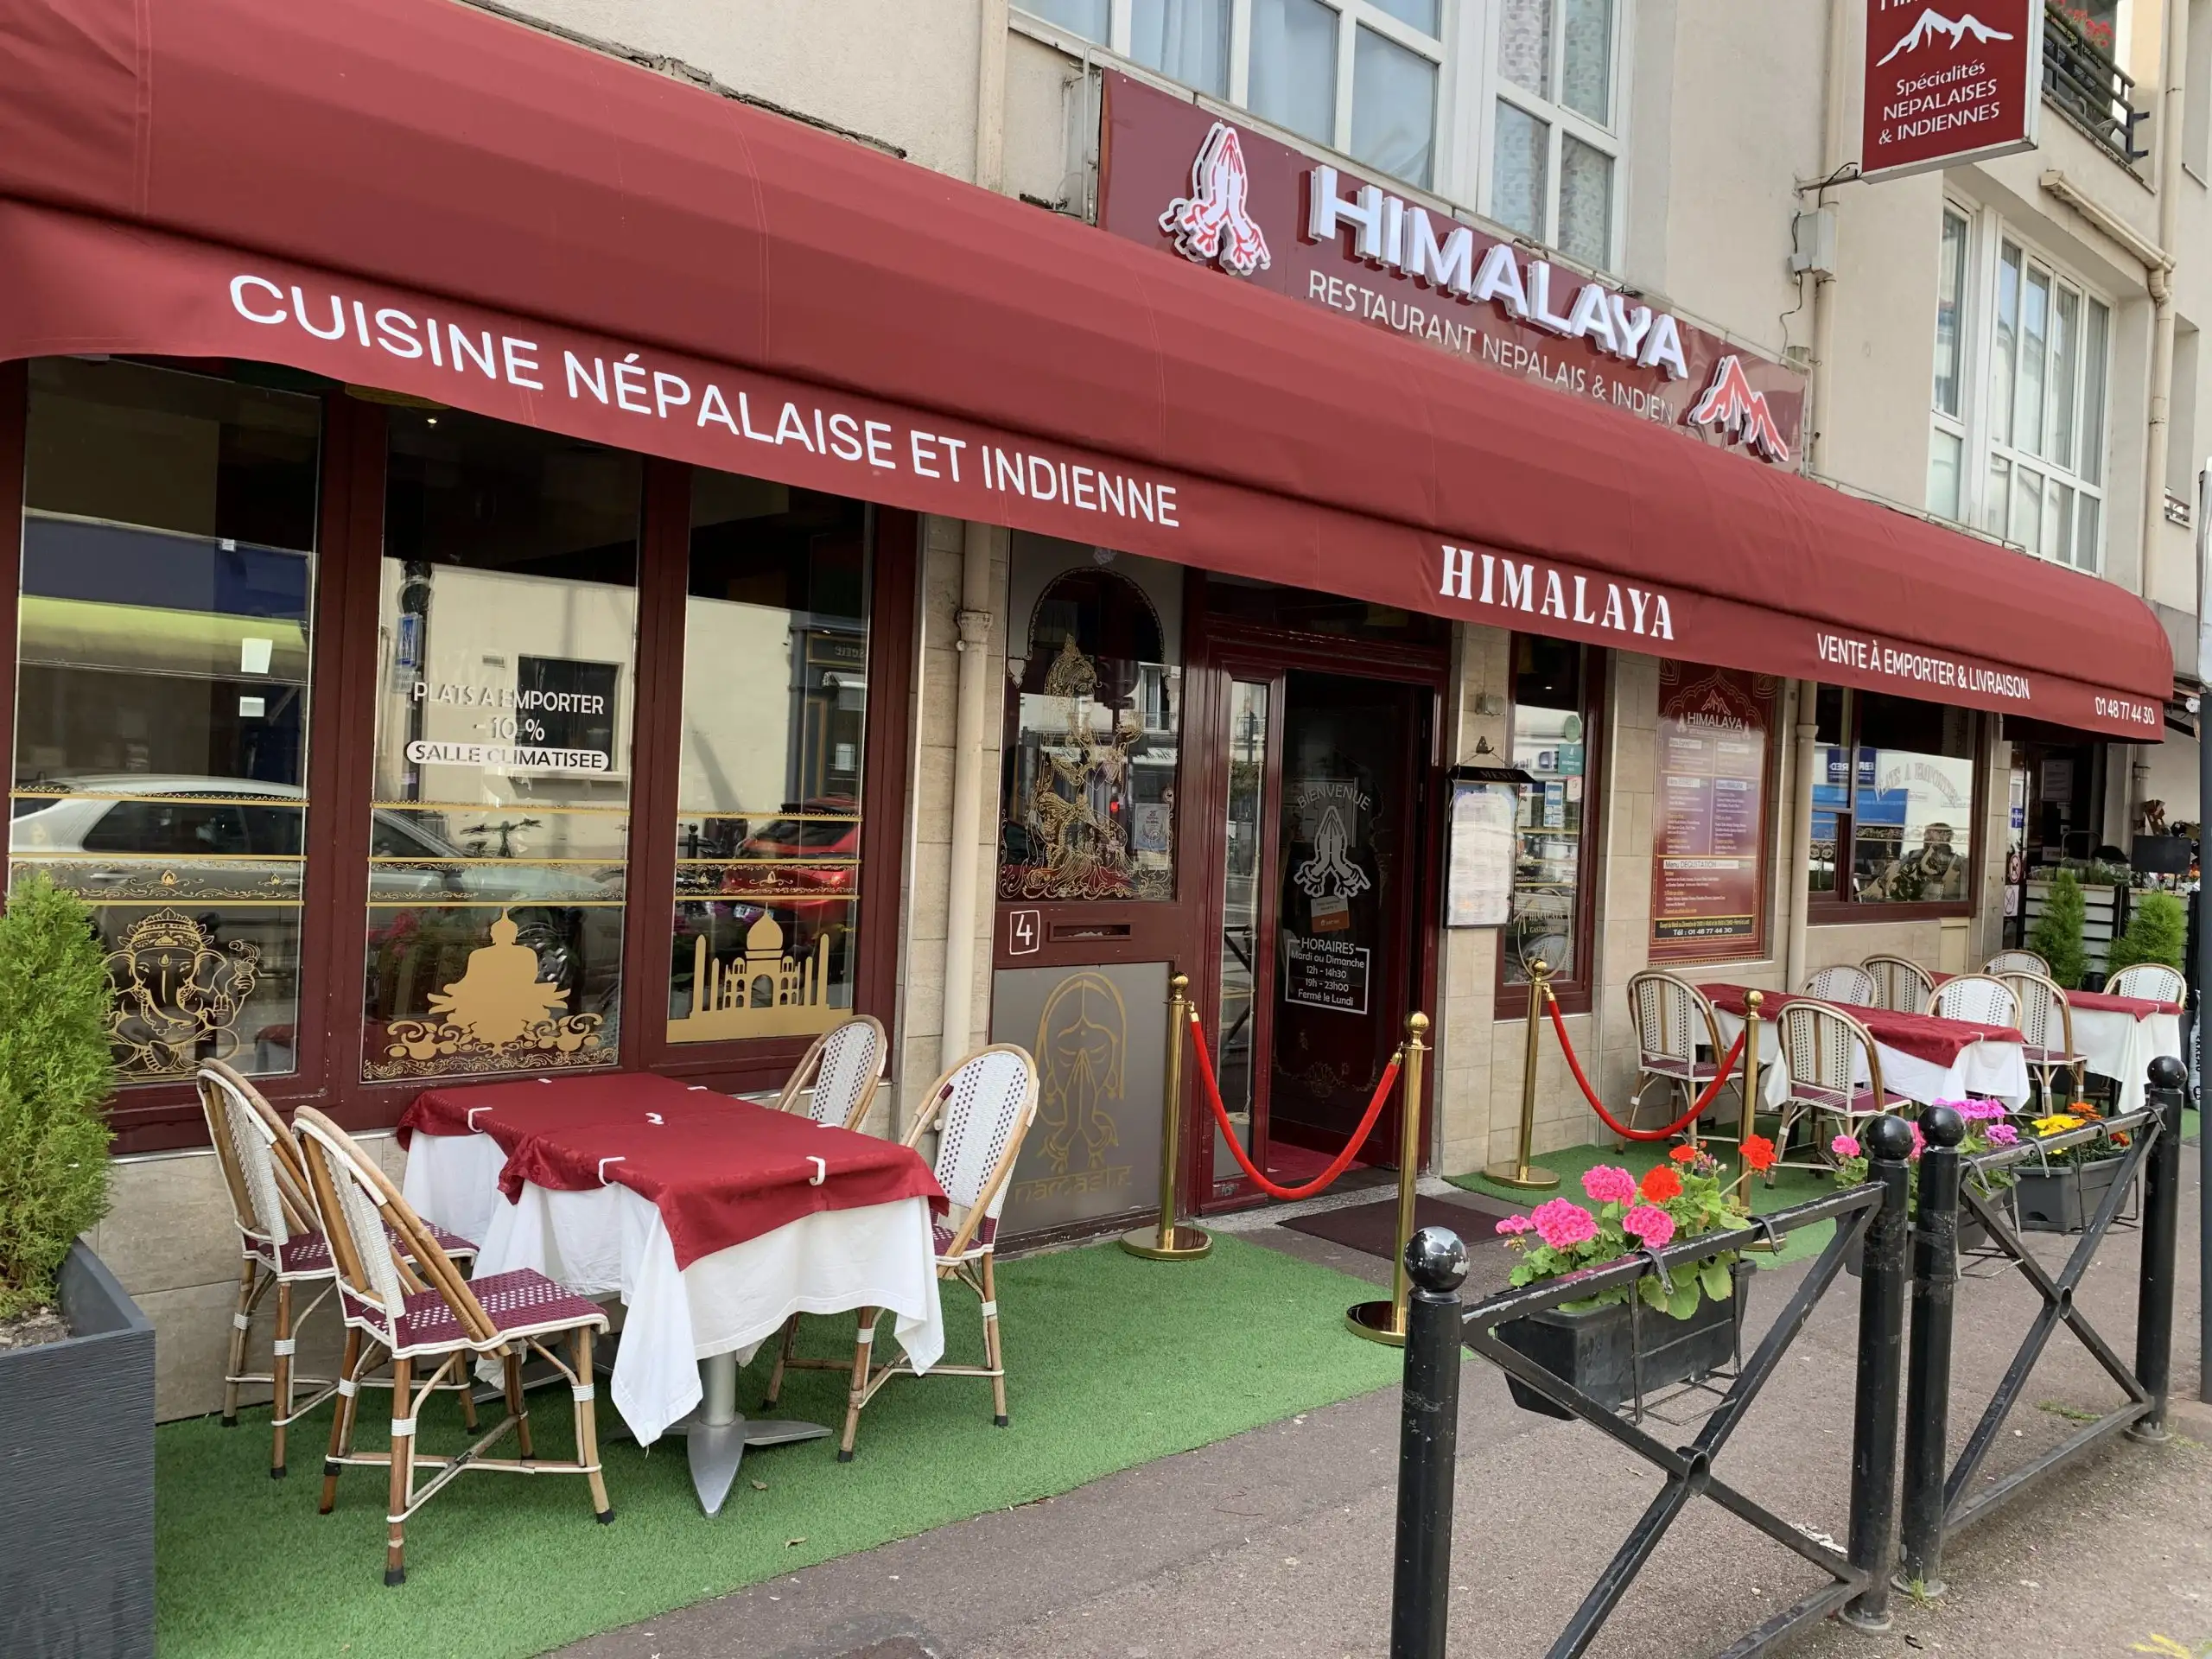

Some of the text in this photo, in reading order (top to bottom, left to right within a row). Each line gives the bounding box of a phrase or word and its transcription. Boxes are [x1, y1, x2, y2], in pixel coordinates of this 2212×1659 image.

[1897, 59, 1986, 96] Spécialités
[1884, 79, 1997, 121] NEPALAISES
[1878, 101, 2000, 145] & INDIENNES
[1308, 164, 1688, 380] HIMALAYA
[1309, 270, 1675, 424] RESTAURANT NEPALAIS & INDIEN
[230, 275, 1179, 527] CUISINE NÉPALAISE ET INDIENNE
[1440, 545, 1674, 639] HIMALAYA
[1817, 632, 2031, 700] VENTE À EMPORTER & LIVRAISON
[413, 681, 475, 706] PLATS
[480, 687, 493, 707] A
[501, 688, 604, 715] EMPORTER
[2095, 696, 2154, 725] 01 48 77 44 30
[1687, 711, 1743, 730] HIMALAYA
[415, 744, 602, 769] SALLE CLIMATISEE
[1297, 785, 1370, 810] BIENVENUE
[1015, 913, 1033, 946] 4
[1291, 950, 1364, 968] Mardi au Dimanche
[1301, 938, 1354, 955] HORAIRES
[1306, 965, 1318, 975] 12h
[1325, 968, 1346, 978] 14h30
[1306, 978, 1317, 988] 19h
[1324, 981, 1349, 992] 23h00
[1298, 988, 1354, 1006] Fermé le Lundi
